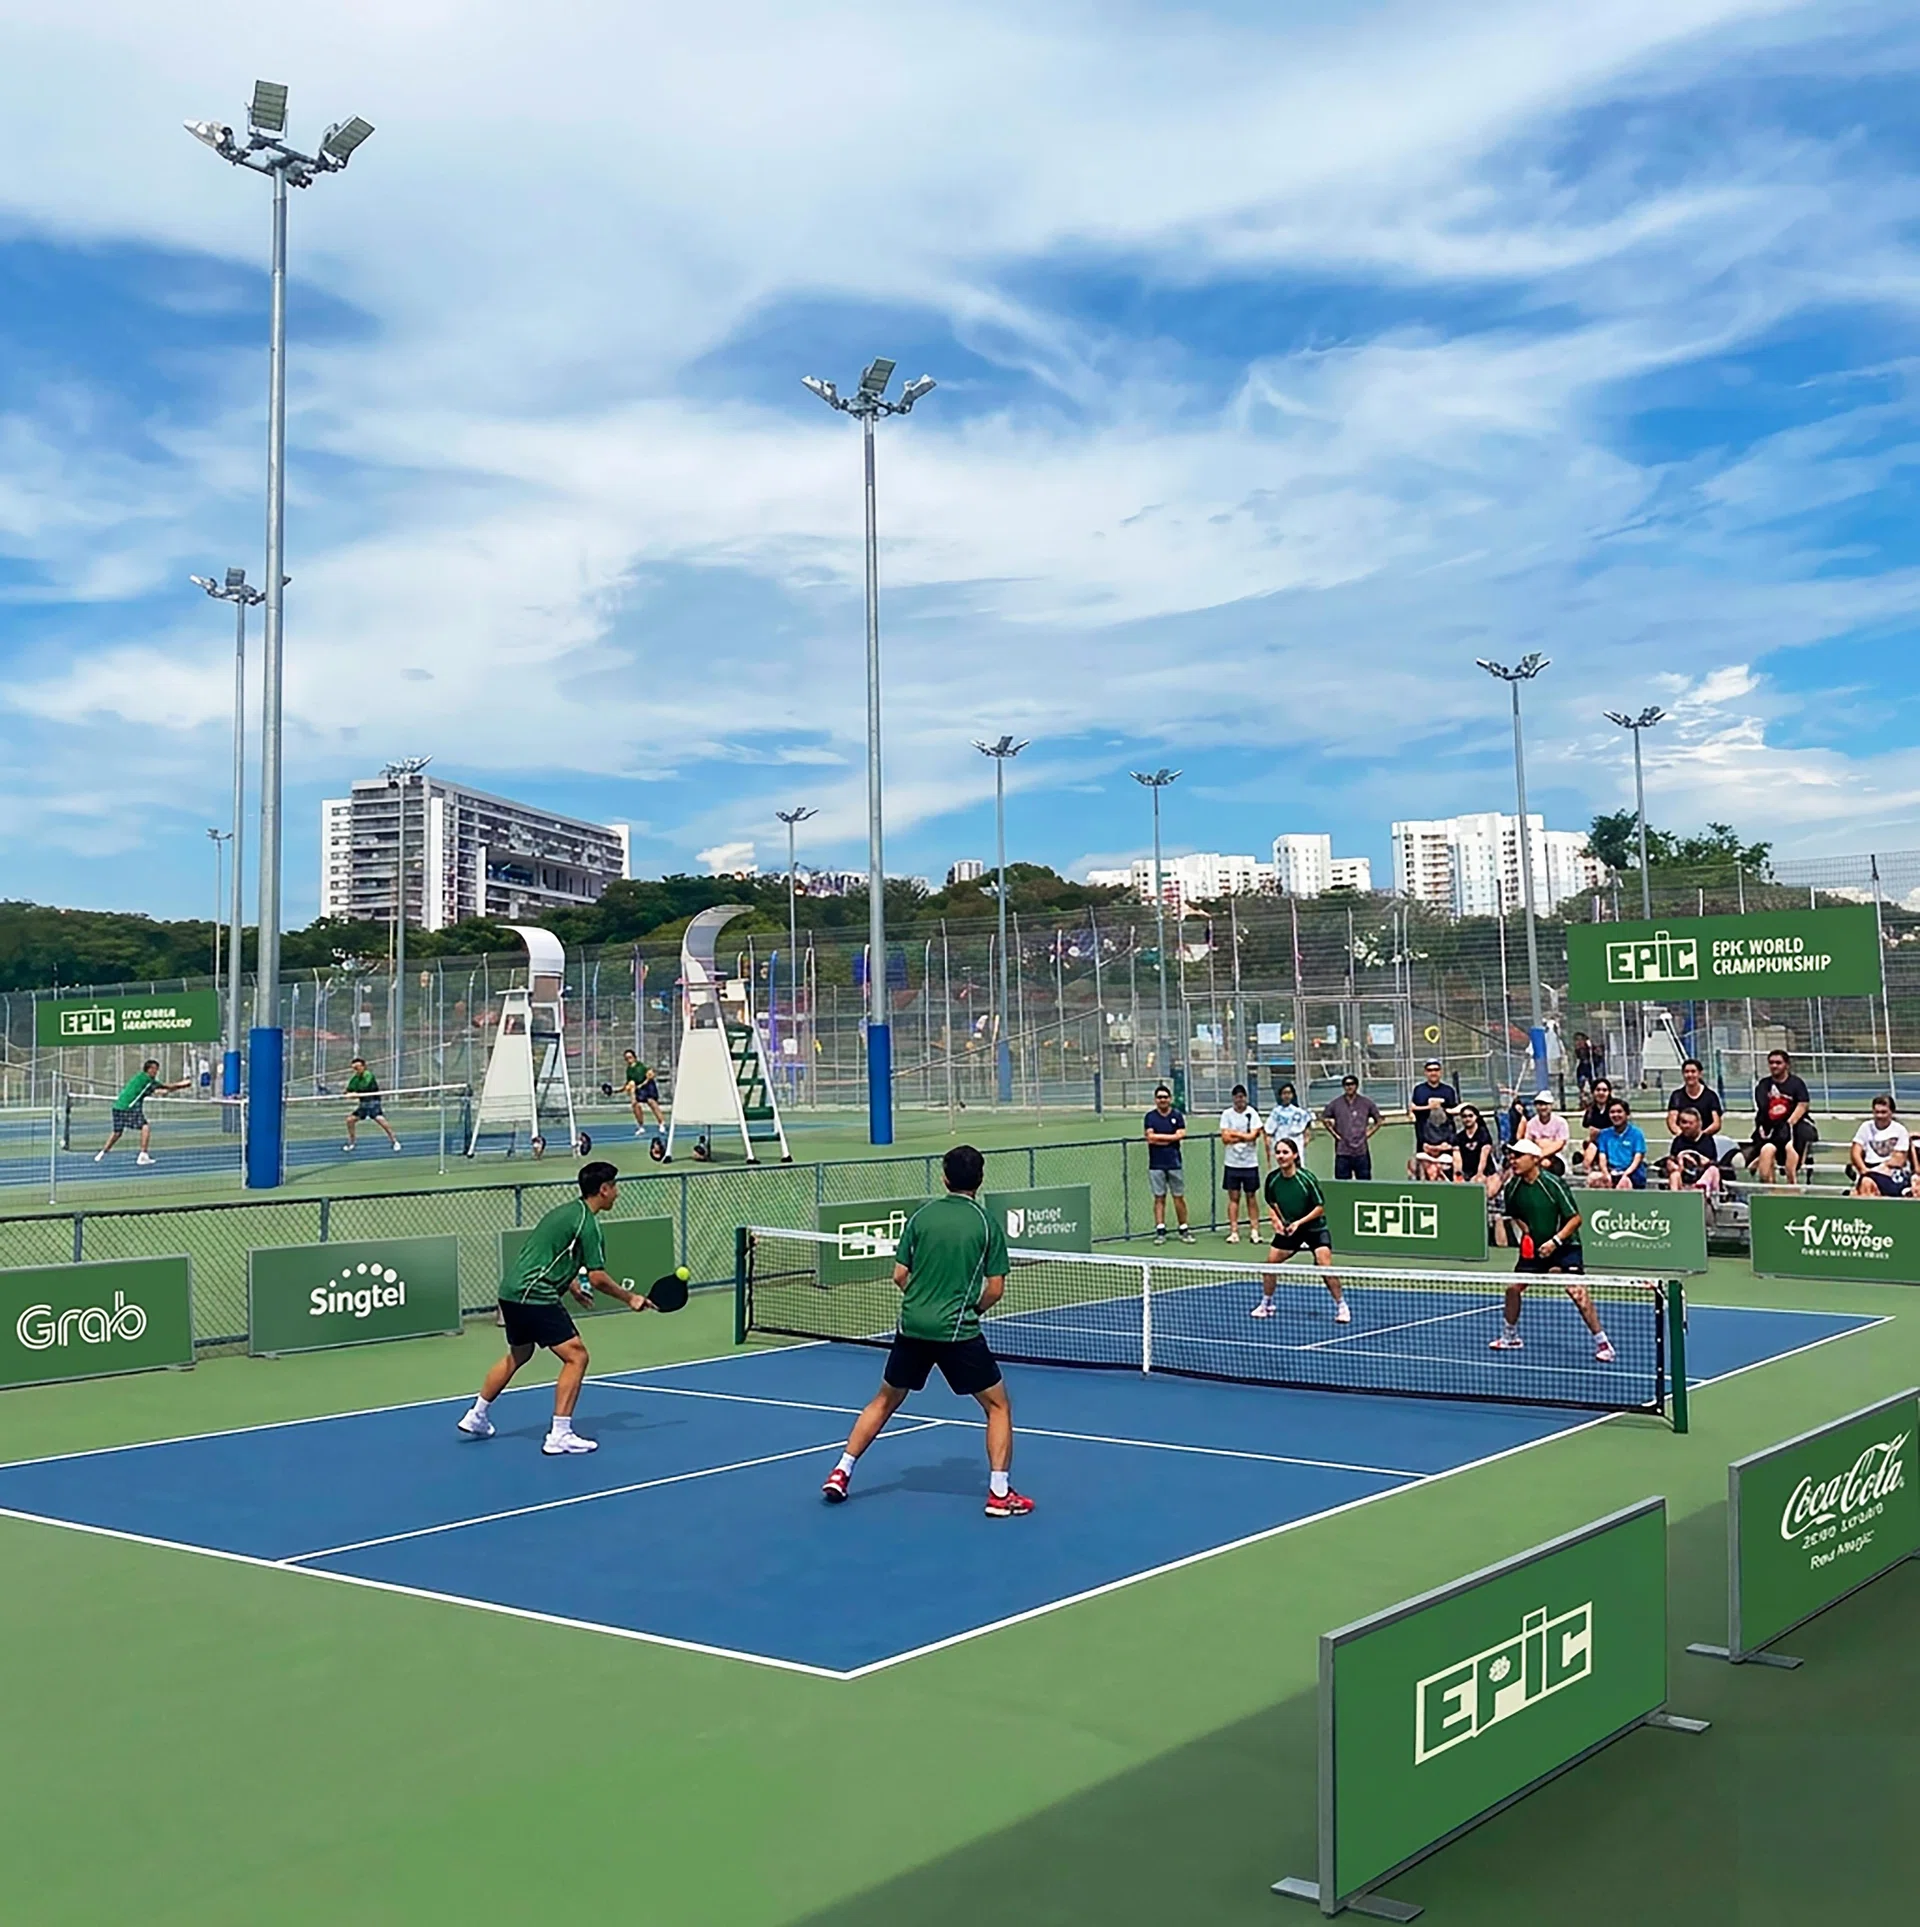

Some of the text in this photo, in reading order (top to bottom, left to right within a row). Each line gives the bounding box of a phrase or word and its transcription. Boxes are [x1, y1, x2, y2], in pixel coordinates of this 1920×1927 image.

[1748, 937, 1804, 955] WORLD
[309, 1281, 406, 1318] Singtel
[16, 1291, 147, 1350] Grab
